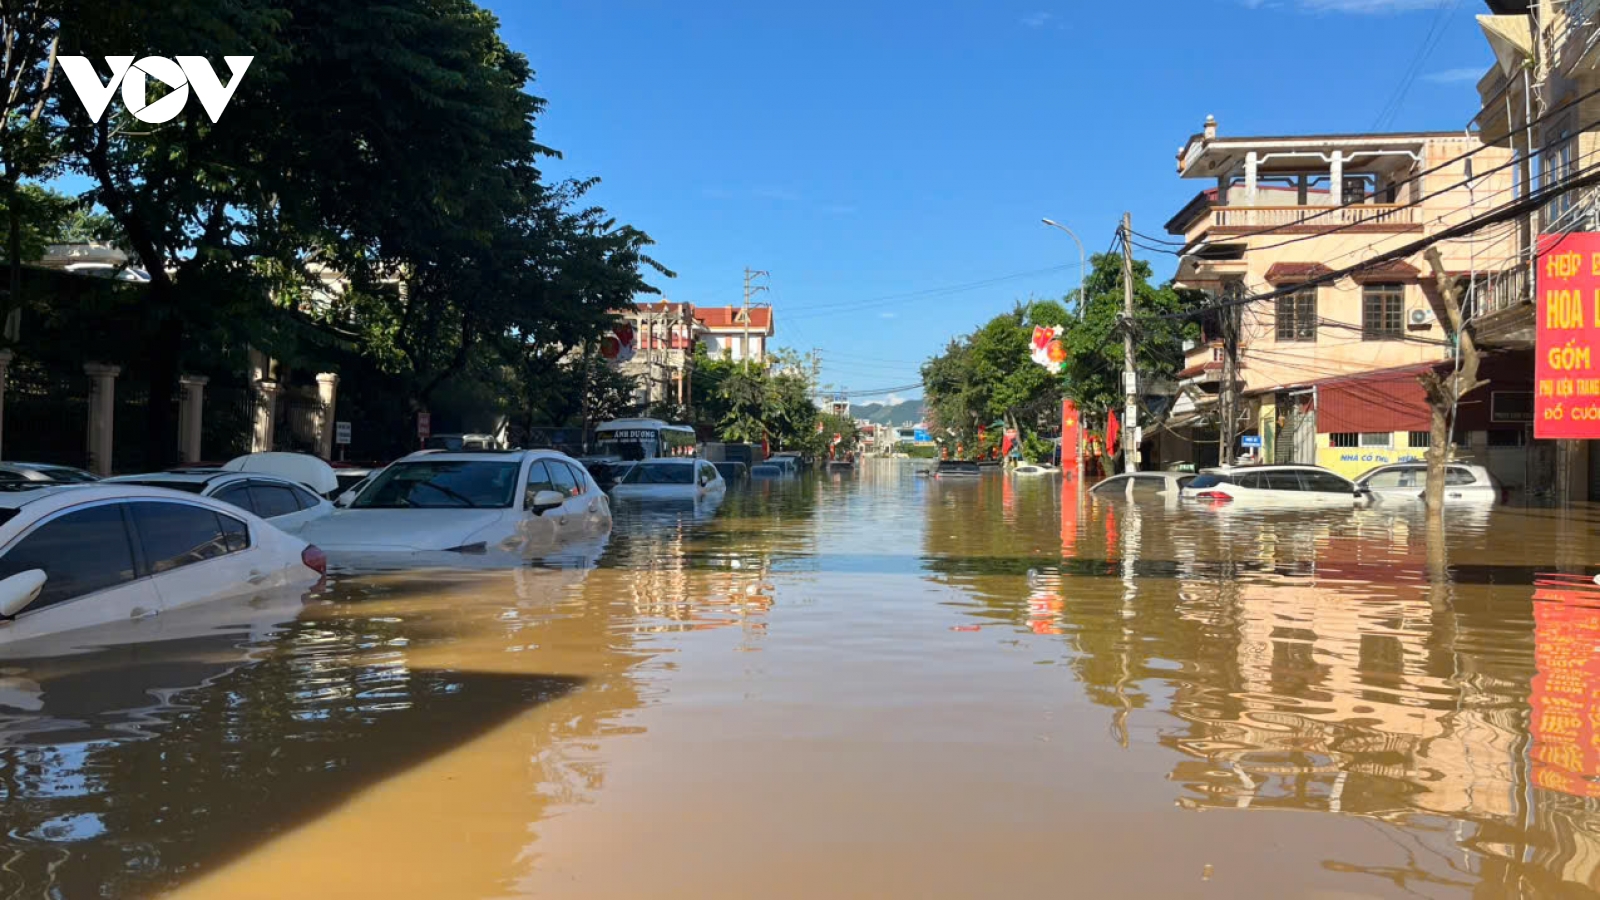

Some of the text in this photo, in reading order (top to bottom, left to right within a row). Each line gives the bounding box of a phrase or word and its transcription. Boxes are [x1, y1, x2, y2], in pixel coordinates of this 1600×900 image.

[1546, 251, 1581, 281] HỢP
[1547, 289, 1584, 329] HOA
[1548, 338, 1590, 370] GỐM
